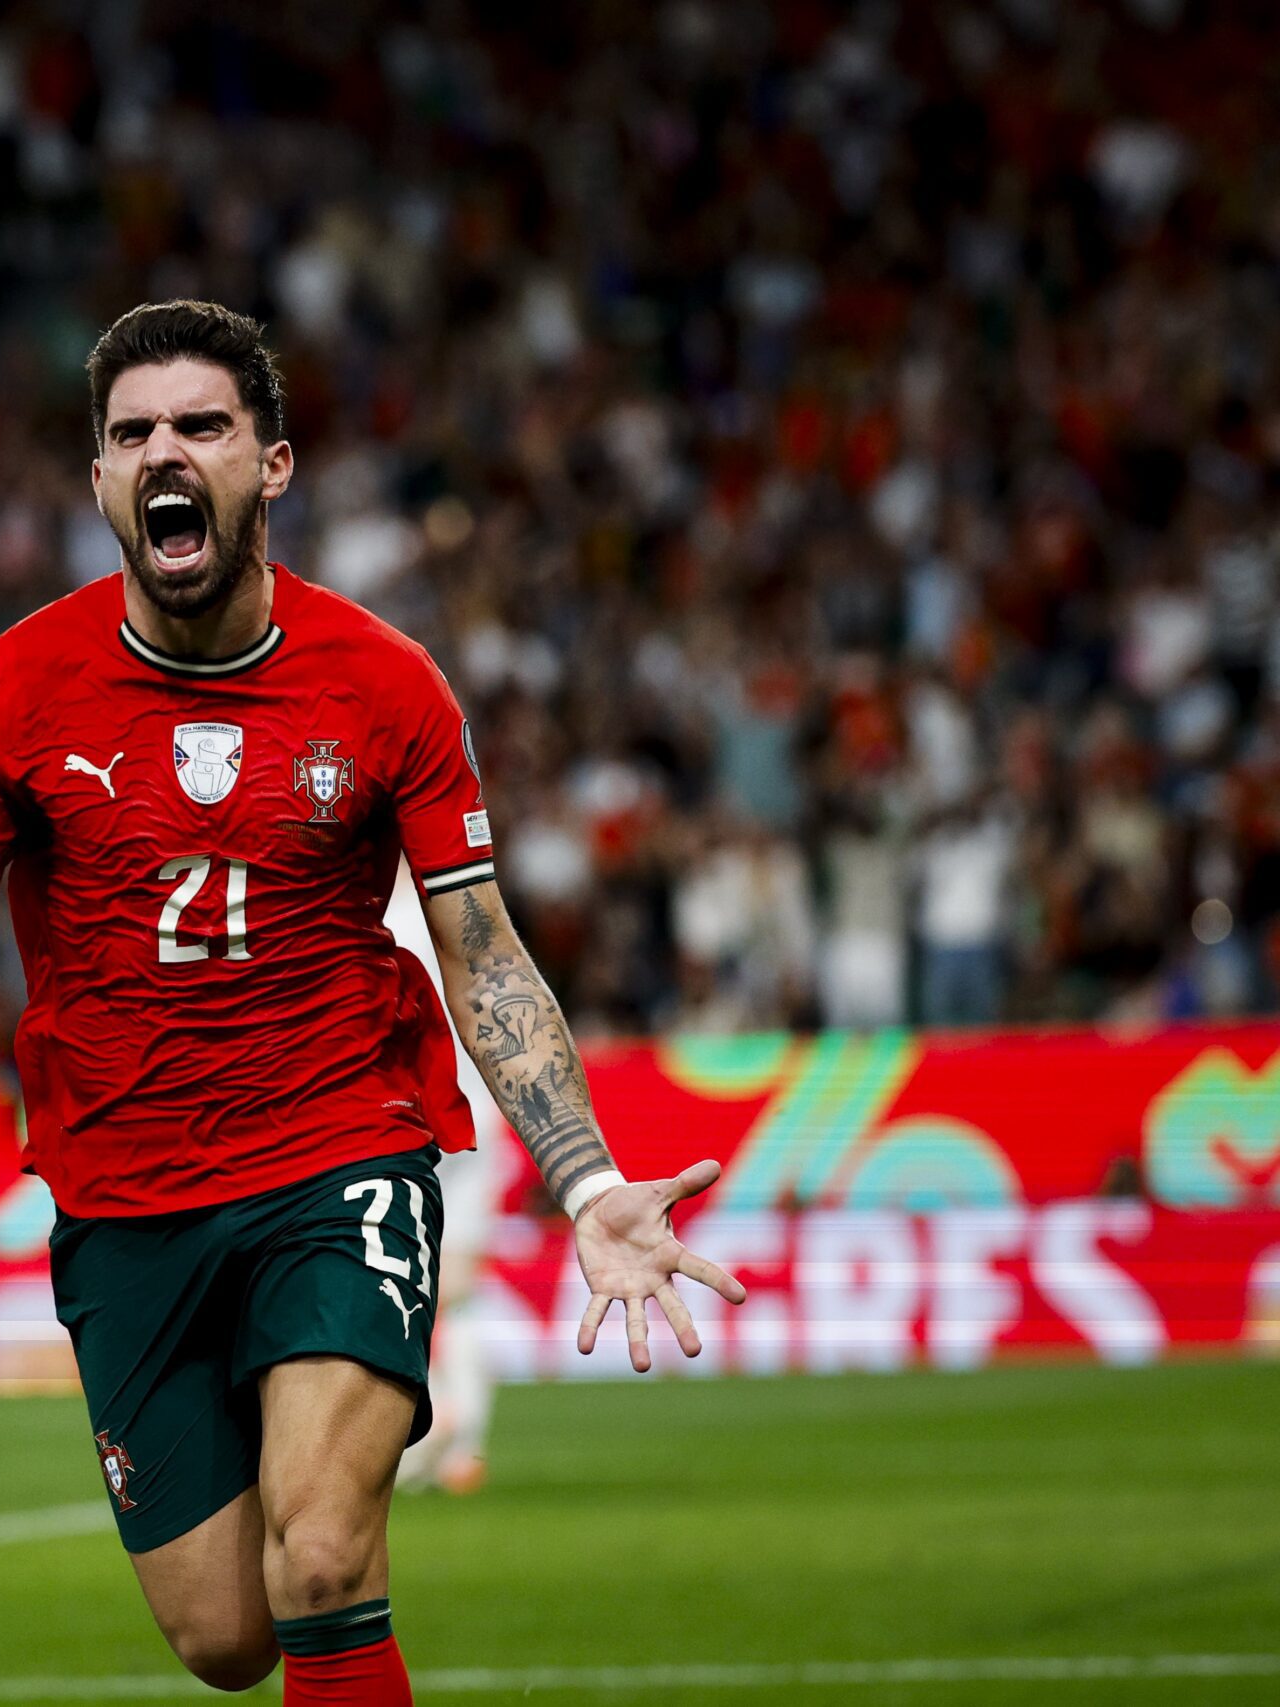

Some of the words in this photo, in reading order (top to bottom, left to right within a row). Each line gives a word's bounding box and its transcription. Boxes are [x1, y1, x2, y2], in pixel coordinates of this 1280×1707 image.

[218, 726, 239, 734] LEAGUE
[157, 855, 254, 963] 21
[343, 1177, 433, 1300] 21
